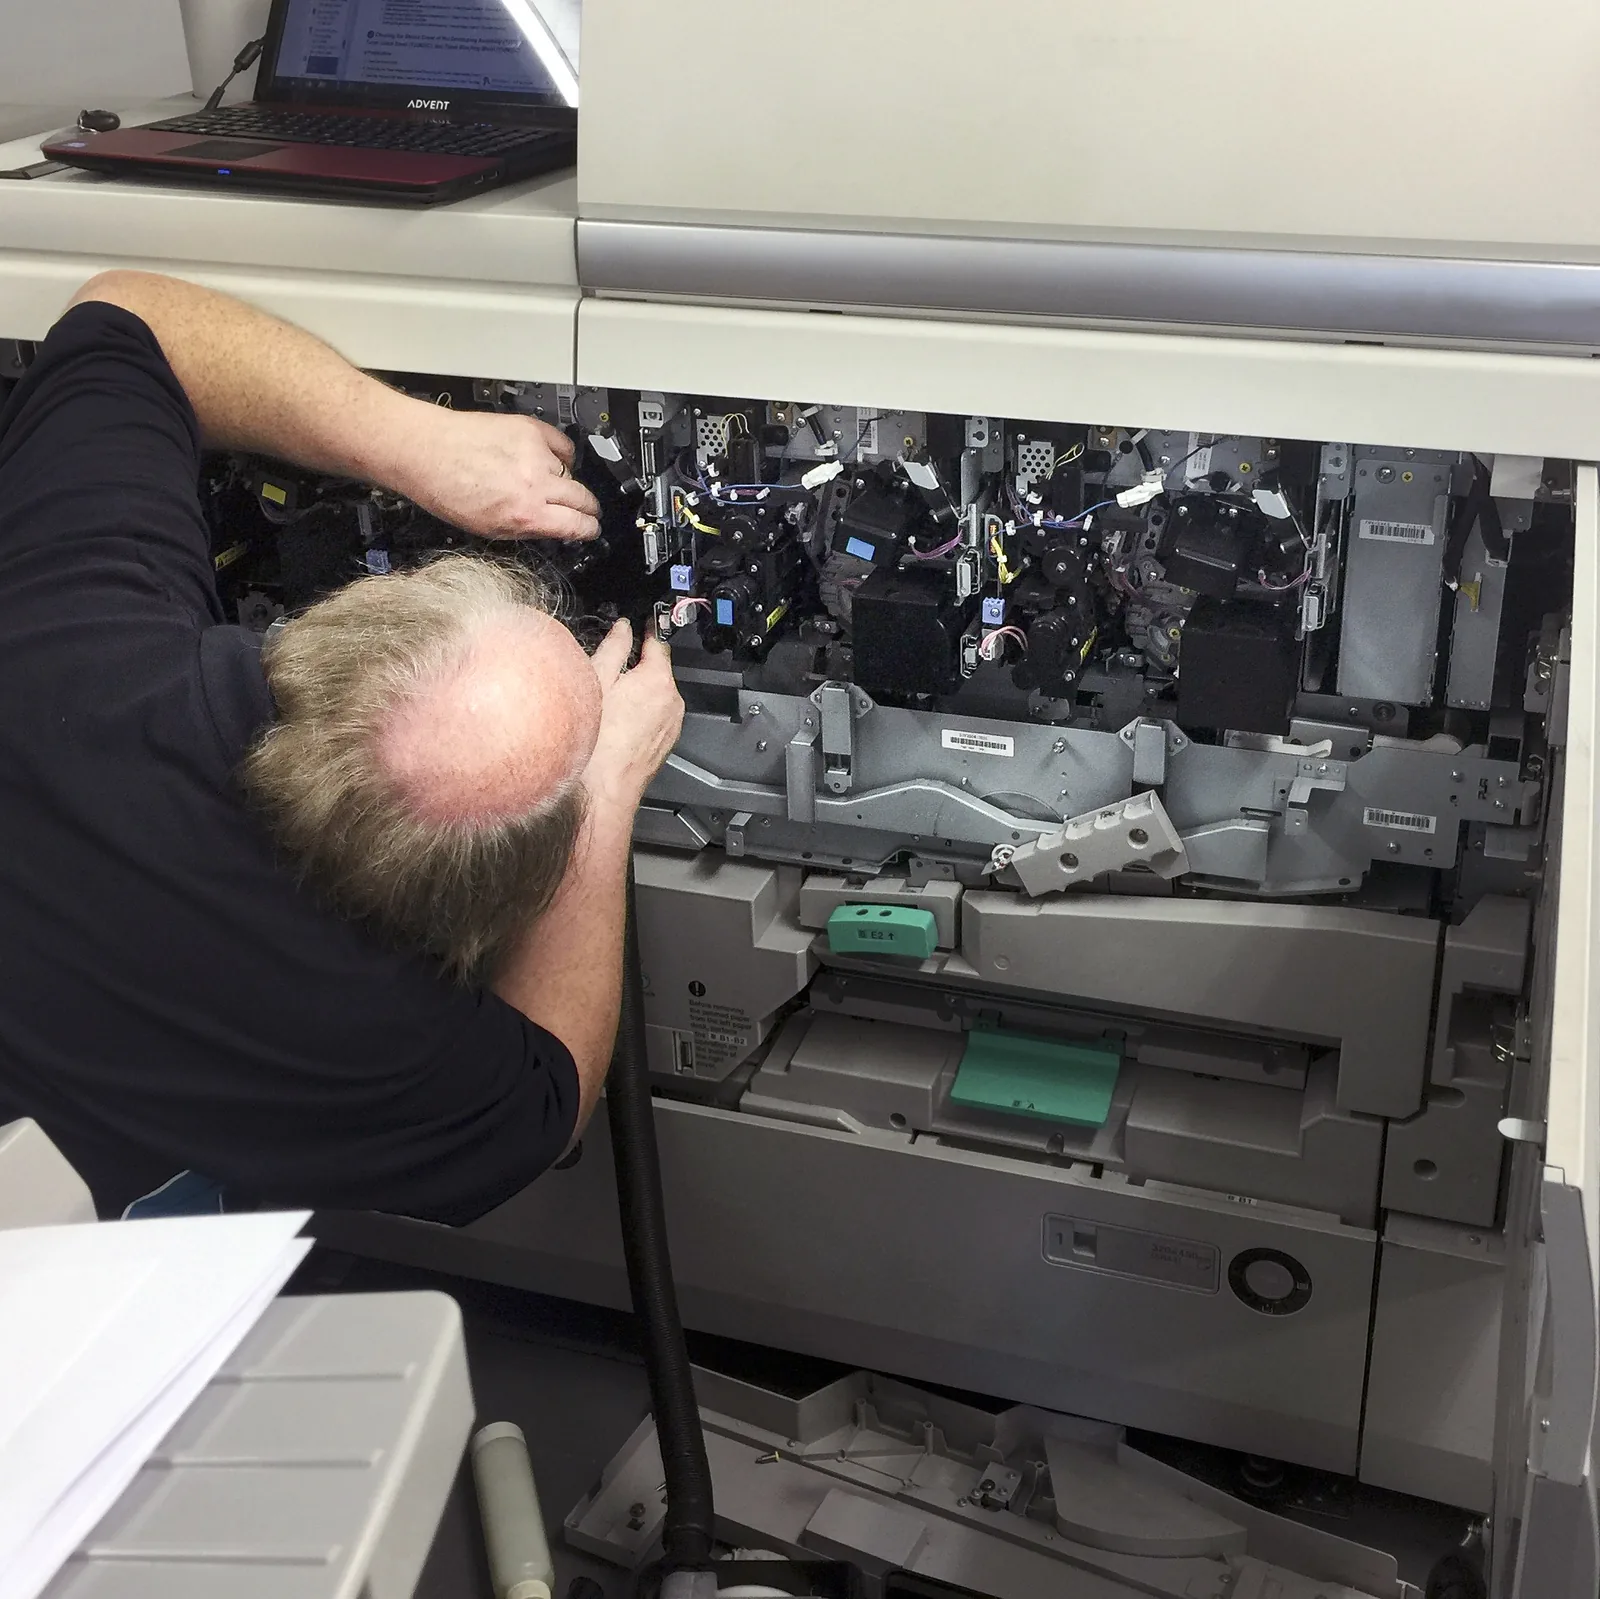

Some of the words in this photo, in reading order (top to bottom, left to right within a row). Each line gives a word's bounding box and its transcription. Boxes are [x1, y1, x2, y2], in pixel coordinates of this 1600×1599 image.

[407, 99, 450, 111] ADVENT
[871, 931, 884, 940] E2
[712, 1004, 745, 1016] removing
[1027, 1102, 1035, 1110] A
[1056, 1232, 1063, 1246] 1
